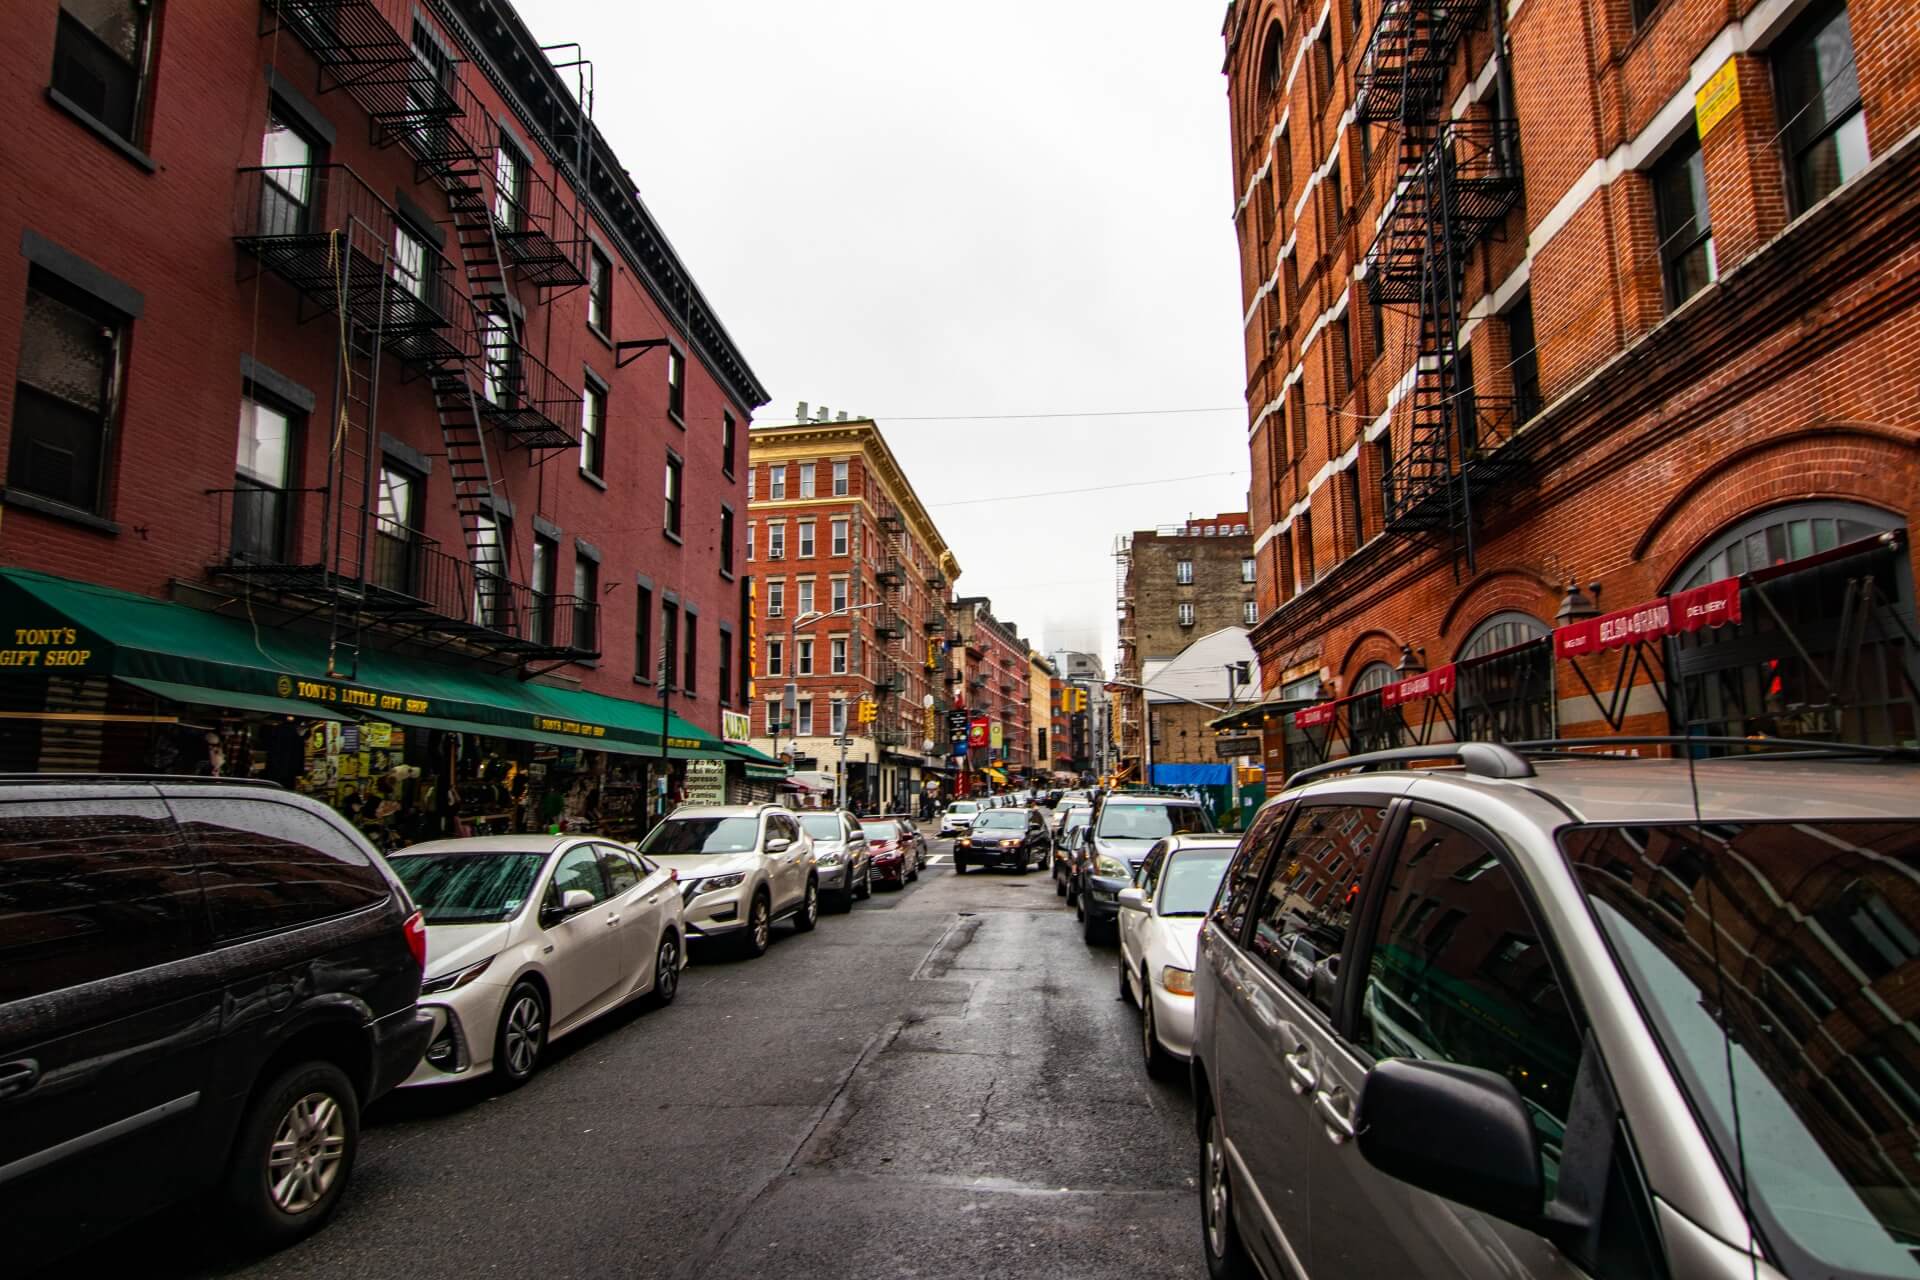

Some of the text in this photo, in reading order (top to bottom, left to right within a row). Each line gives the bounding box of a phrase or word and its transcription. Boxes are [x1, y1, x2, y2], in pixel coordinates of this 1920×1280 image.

[15, 627, 77, 645] TONY'S
[0, 650, 92, 666] GIFT SHOP
[297, 681, 429, 713] TONY'S LITTLE GIFT SHOP
